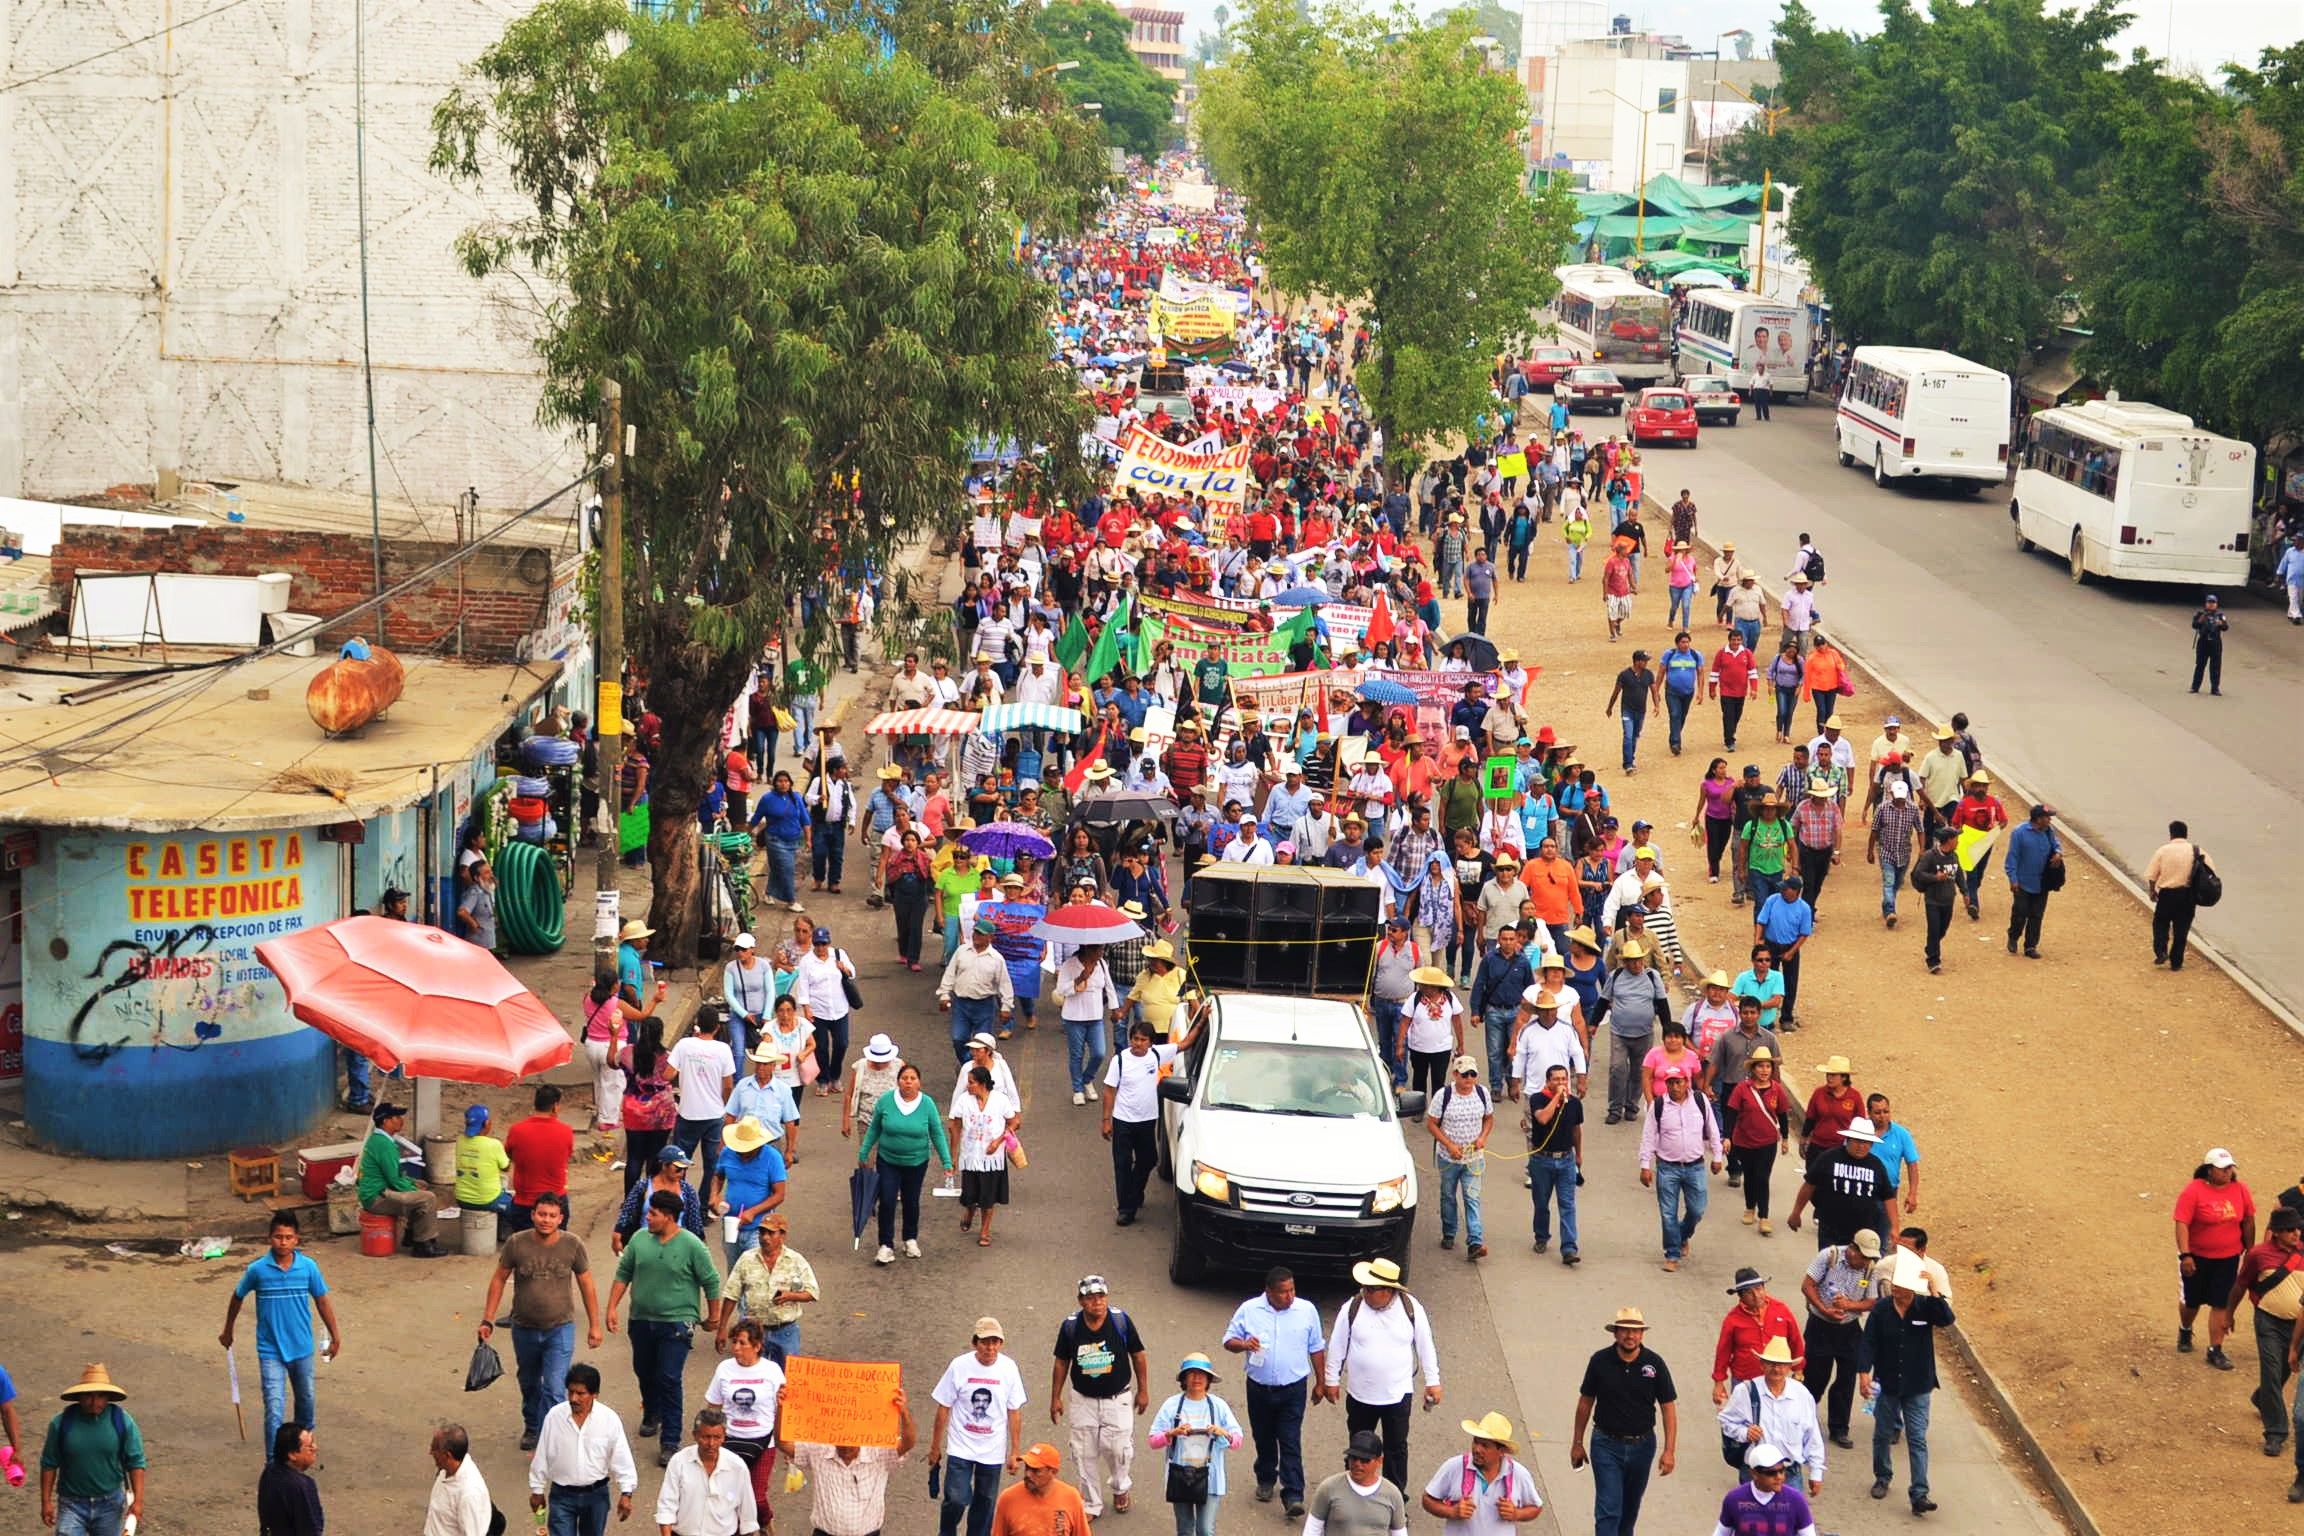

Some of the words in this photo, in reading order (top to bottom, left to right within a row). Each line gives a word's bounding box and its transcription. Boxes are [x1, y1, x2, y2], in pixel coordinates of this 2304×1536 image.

[1922, 378, 1947, 389] A-167
[1130, 466, 1188, 490] con
[1201, 471, 1236, 493] la
[1163, 622, 1271, 647] Libertad
[1175, 645, 1282, 664] mediata
[128, 834, 302, 878] CASETA
[129, 875, 302, 920] TELEFONICA
[268, 919, 283, 933] DE
[285, 916, 303, 929] FAX
[219, 947, 249, 962] LOCAL
[225, 970, 232, 983] E
[1833, 1162, 1875, 1183] HOLLISTER
[1833, 1178, 1874, 1197] 1922
[807, 1391, 858, 1408] FINLANDIA
[819, 1407, 873, 1421] IMPUTADOS
[805, 1416, 845, 1431] MEXICO
[828, 1432, 899, 1446] DIPUTADOS
